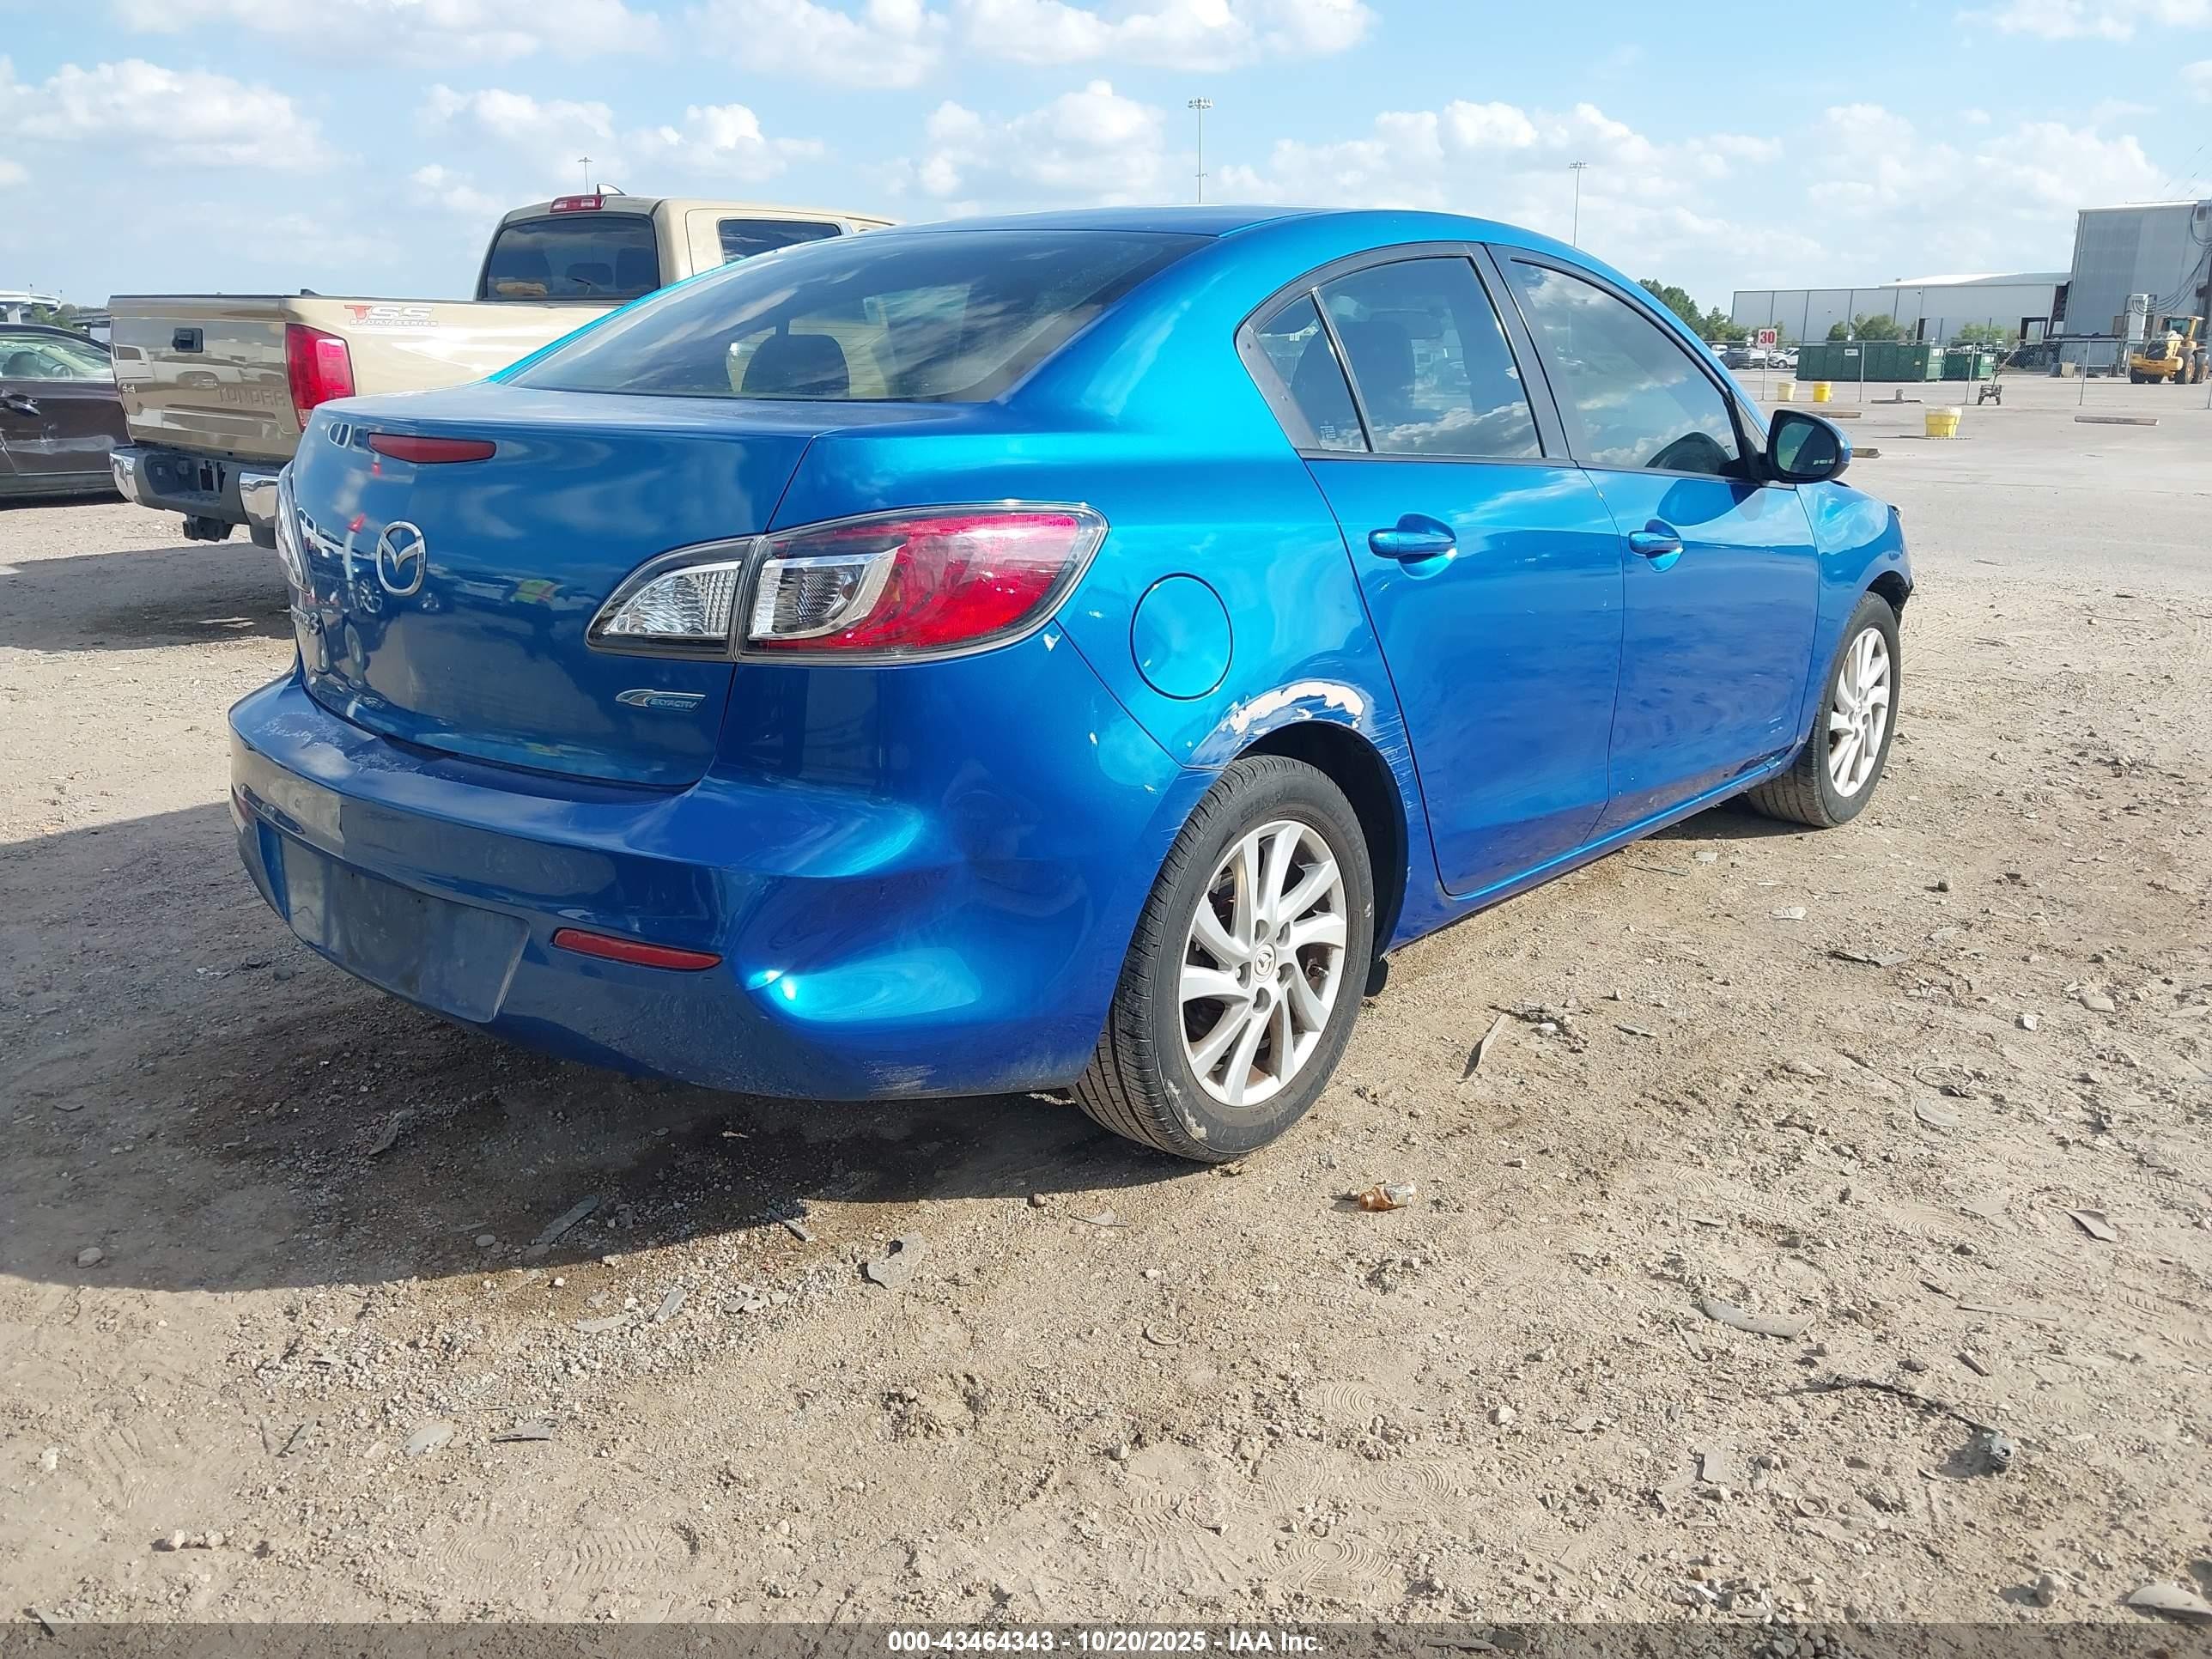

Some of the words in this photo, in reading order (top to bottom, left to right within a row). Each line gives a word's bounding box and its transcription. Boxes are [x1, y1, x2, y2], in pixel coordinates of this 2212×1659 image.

[343, 304, 434, 319] TSS
[1760, 331, 1775, 343] 30
[220, 386, 287, 407] TUNDRA
